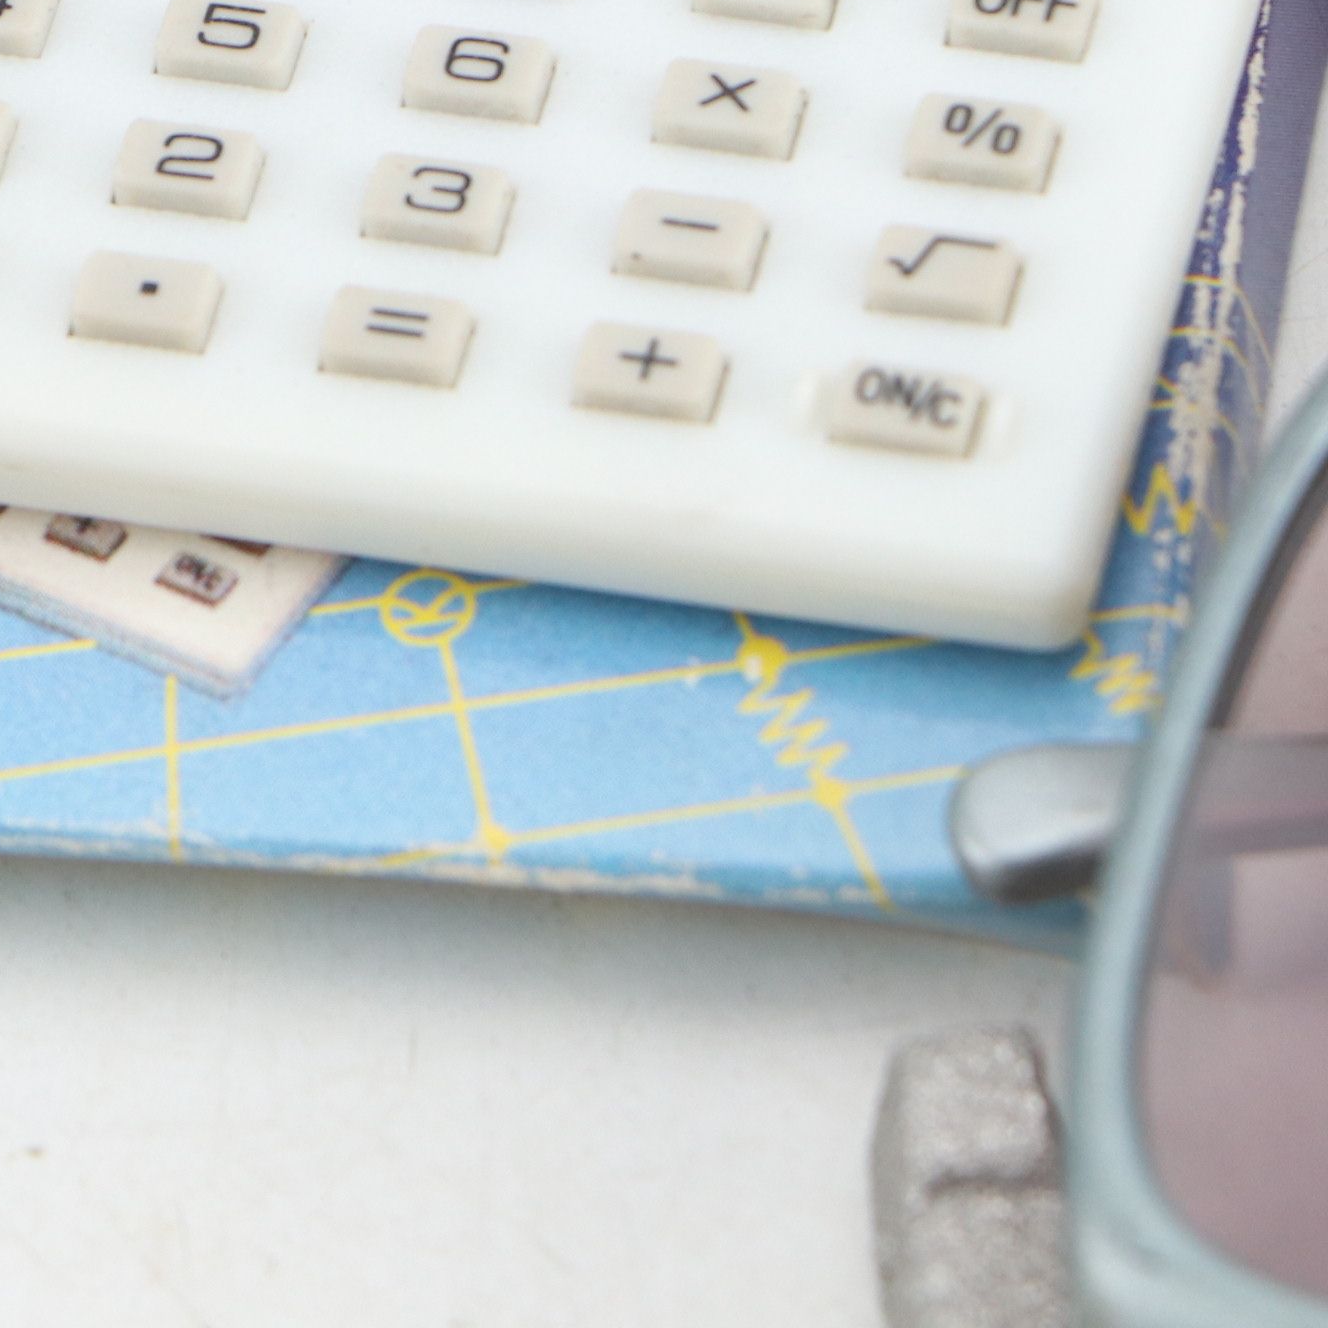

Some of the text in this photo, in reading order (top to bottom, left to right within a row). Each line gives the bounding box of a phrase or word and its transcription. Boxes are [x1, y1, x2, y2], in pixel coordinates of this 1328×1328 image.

[196, 3, 267, 51] 5
[444, 36, 510, 83] 6
[943, 103, 1022, 156] %
[155, 133, 224, 180] 2
[404, 167, 473, 213] 3
[855, 369, 962, 430] ON/C
